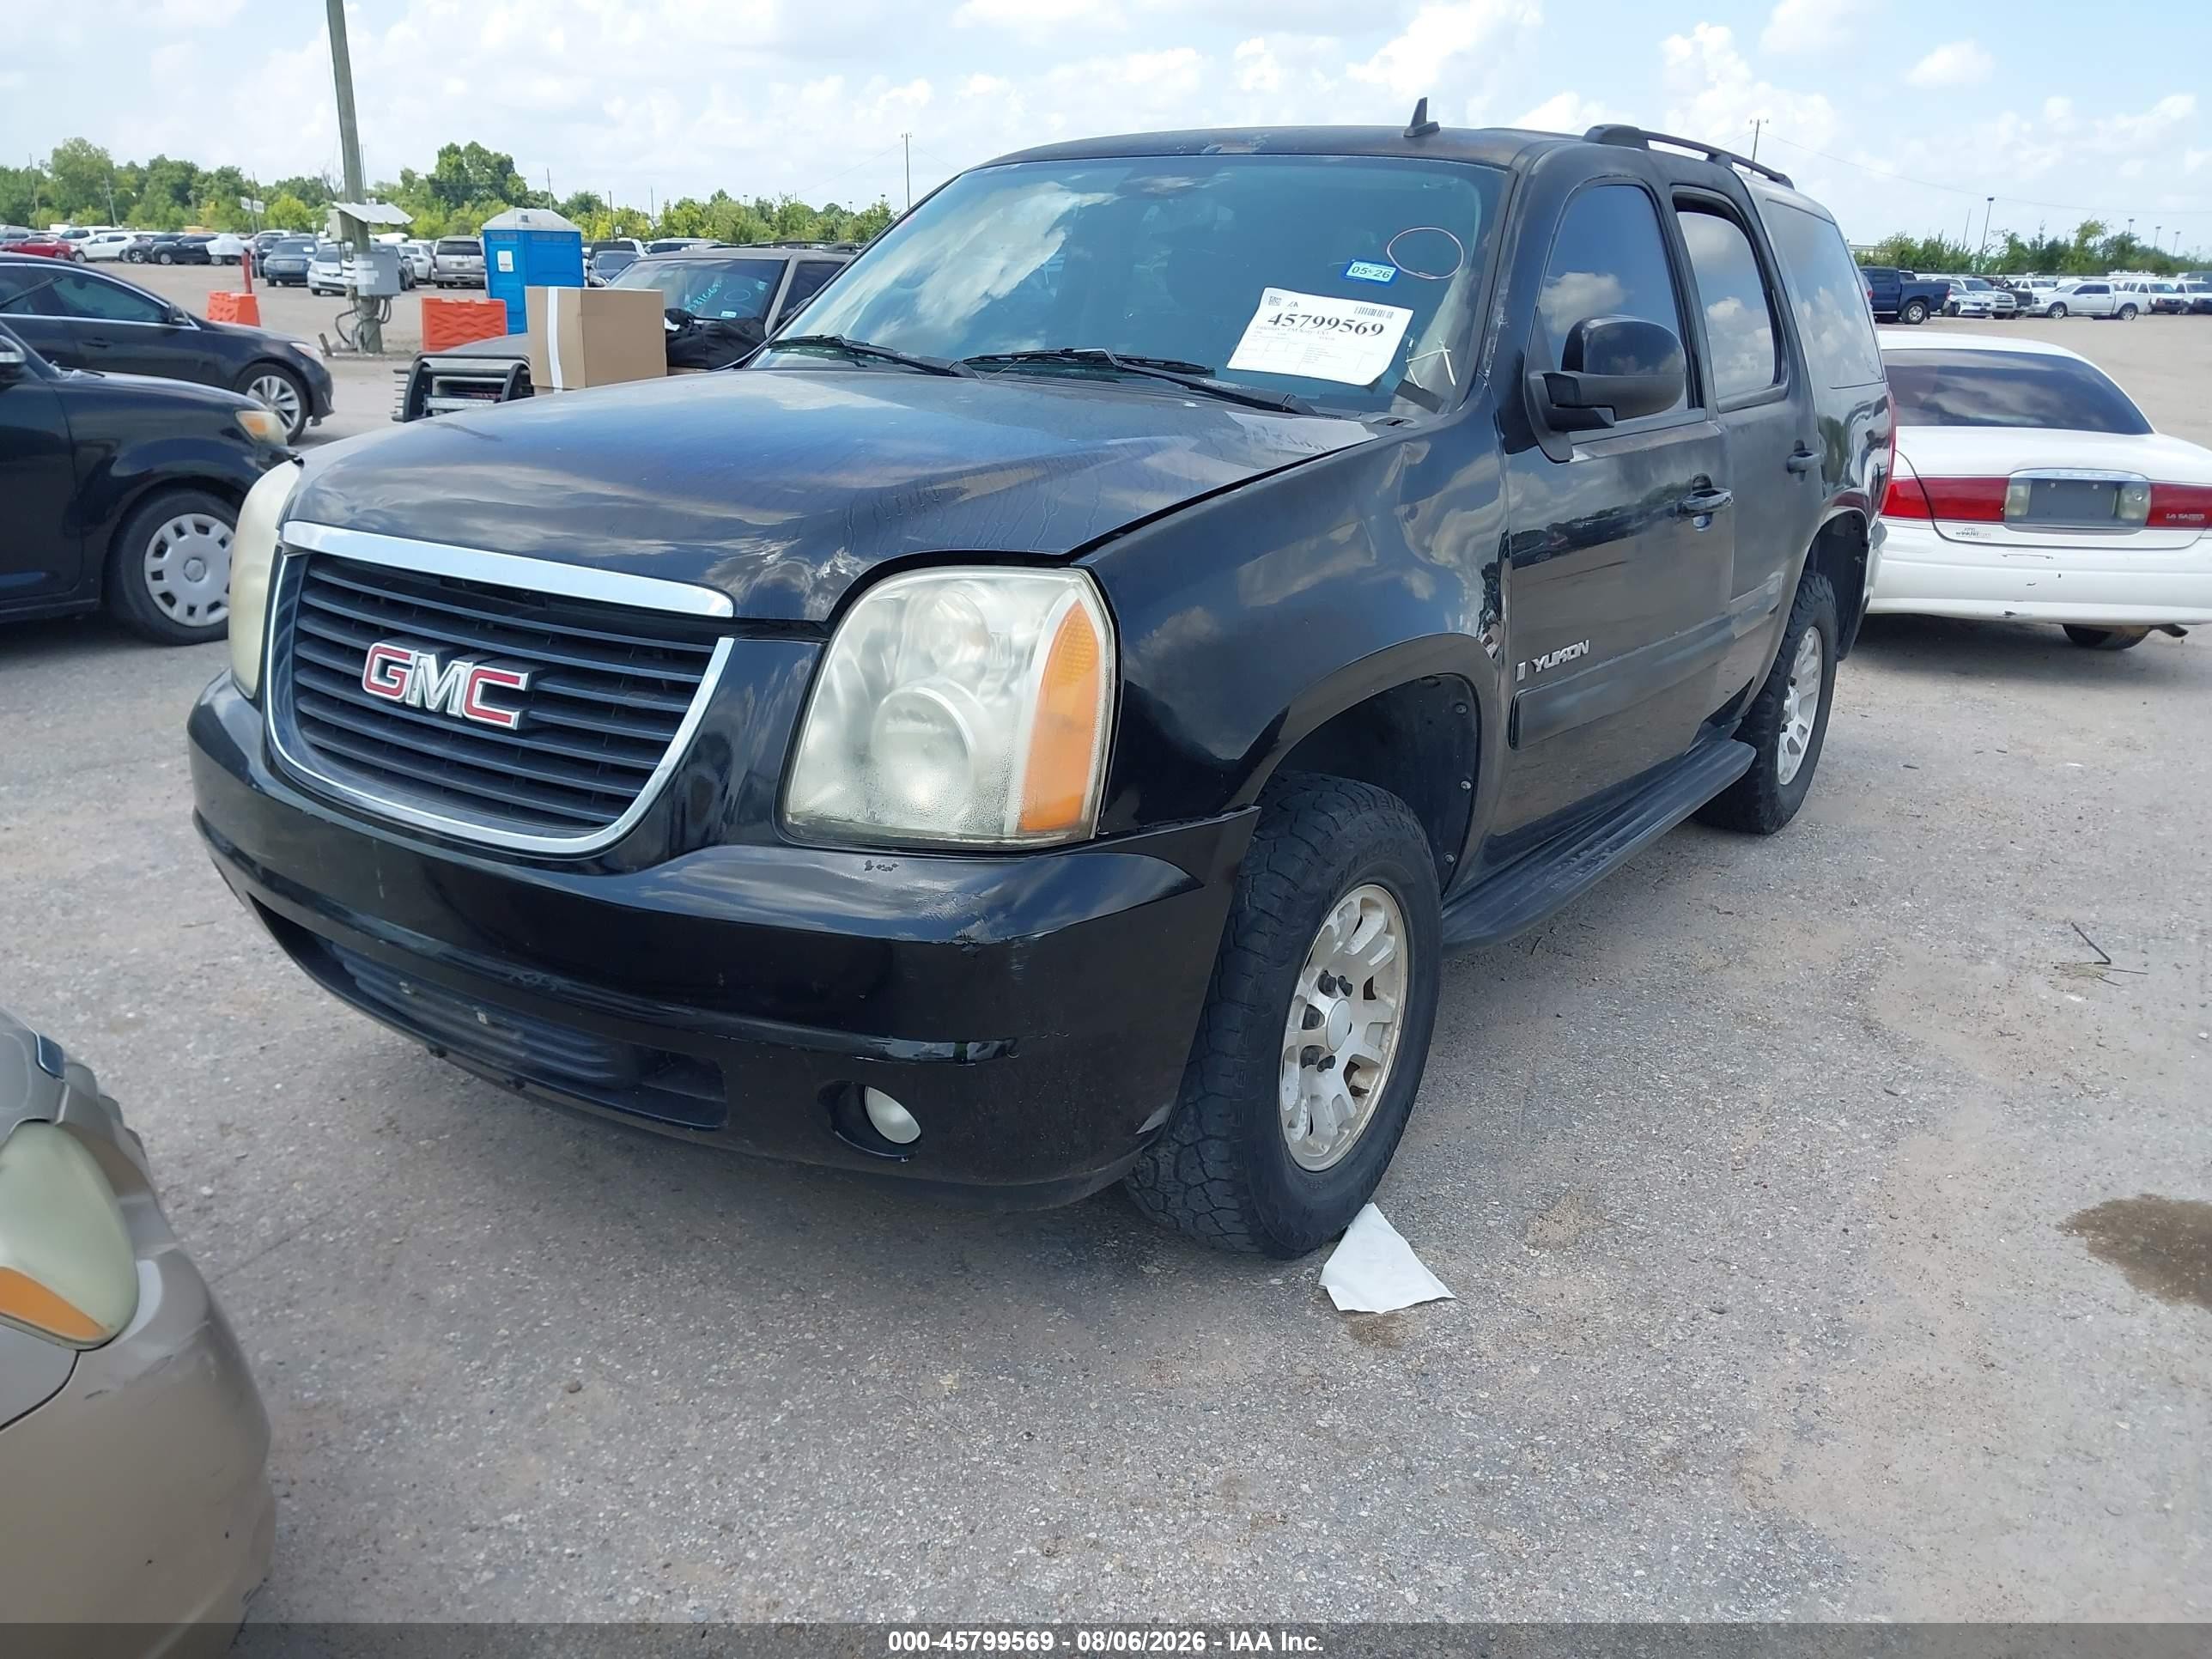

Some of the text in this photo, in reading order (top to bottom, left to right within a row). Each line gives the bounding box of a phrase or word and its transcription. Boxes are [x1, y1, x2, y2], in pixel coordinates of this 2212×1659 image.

[1267, 313, 1385, 337] 45799569
[1531, 639, 1589, 673] YUKON
[362, 642, 529, 730] GMC
